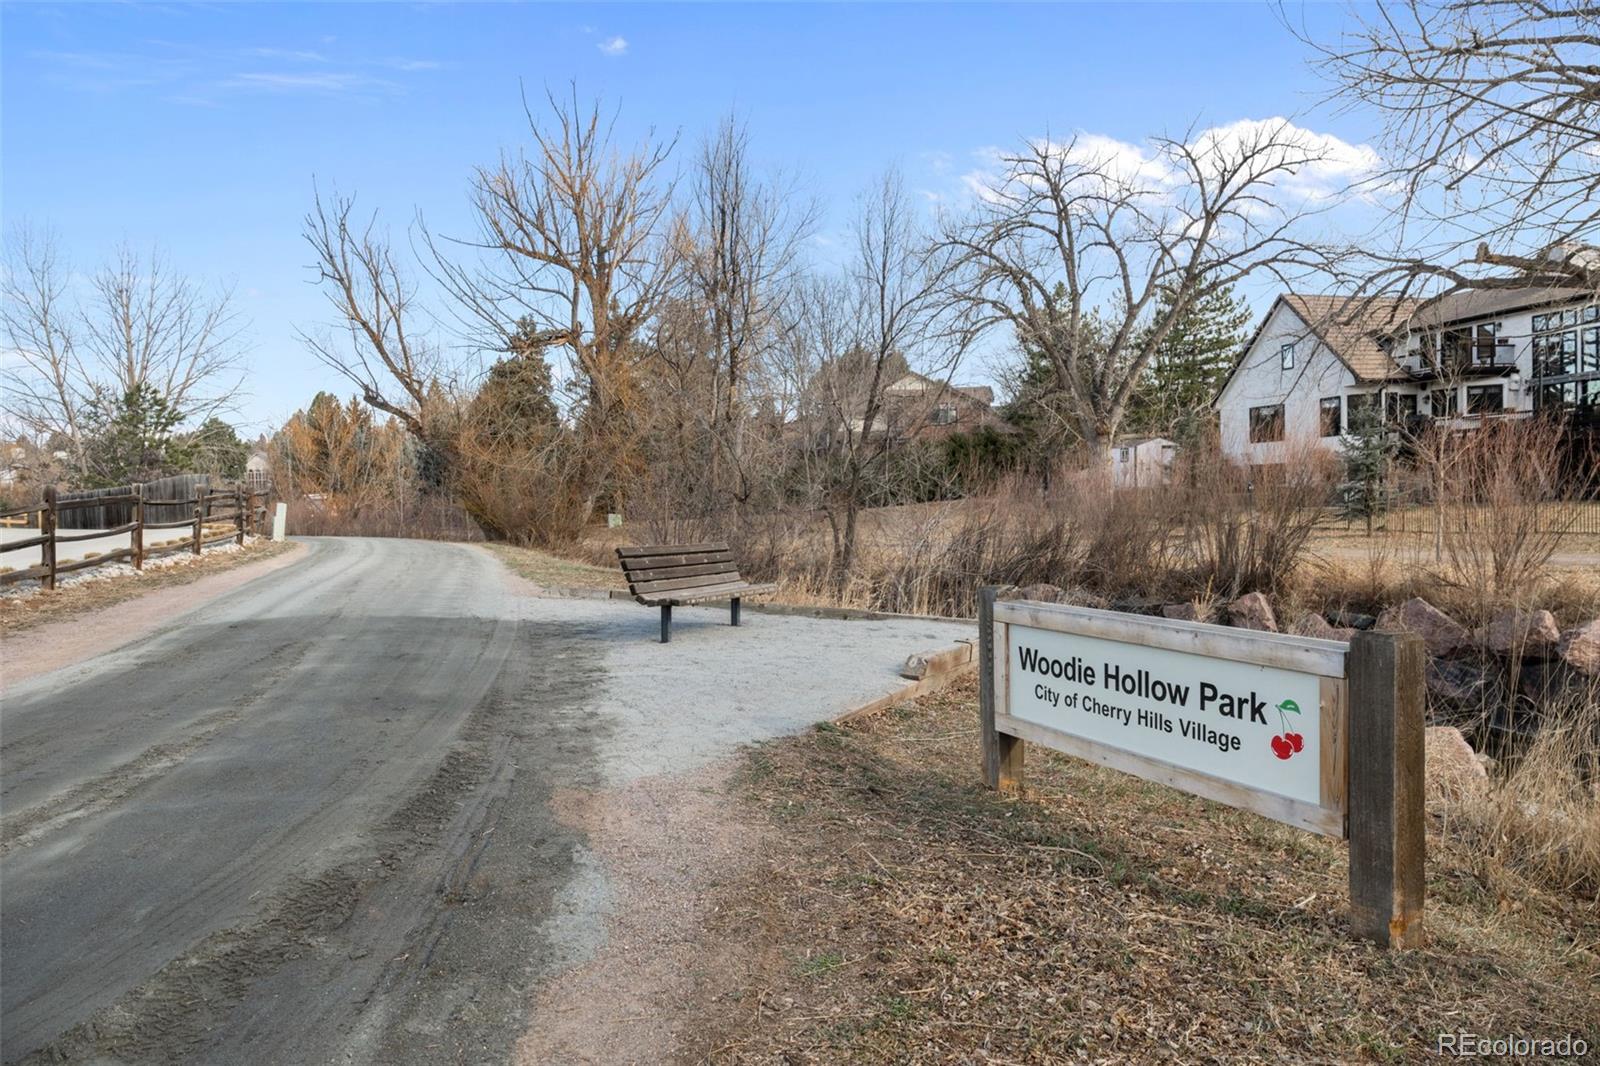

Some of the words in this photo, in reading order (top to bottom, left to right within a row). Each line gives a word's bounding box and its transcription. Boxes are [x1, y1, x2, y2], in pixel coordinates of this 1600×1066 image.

[1018, 646, 1096, 686] Woodie
[1103, 663, 1190, 707] Hollow
[1199, 681, 1268, 726] Park
[1034, 684, 1060, 708] City
[1064, 693, 1078, 709] of
[1082, 696, 1132, 727] Cherry
[1137, 709, 1173, 734] Hills
[1179, 719, 1241, 752] Village
